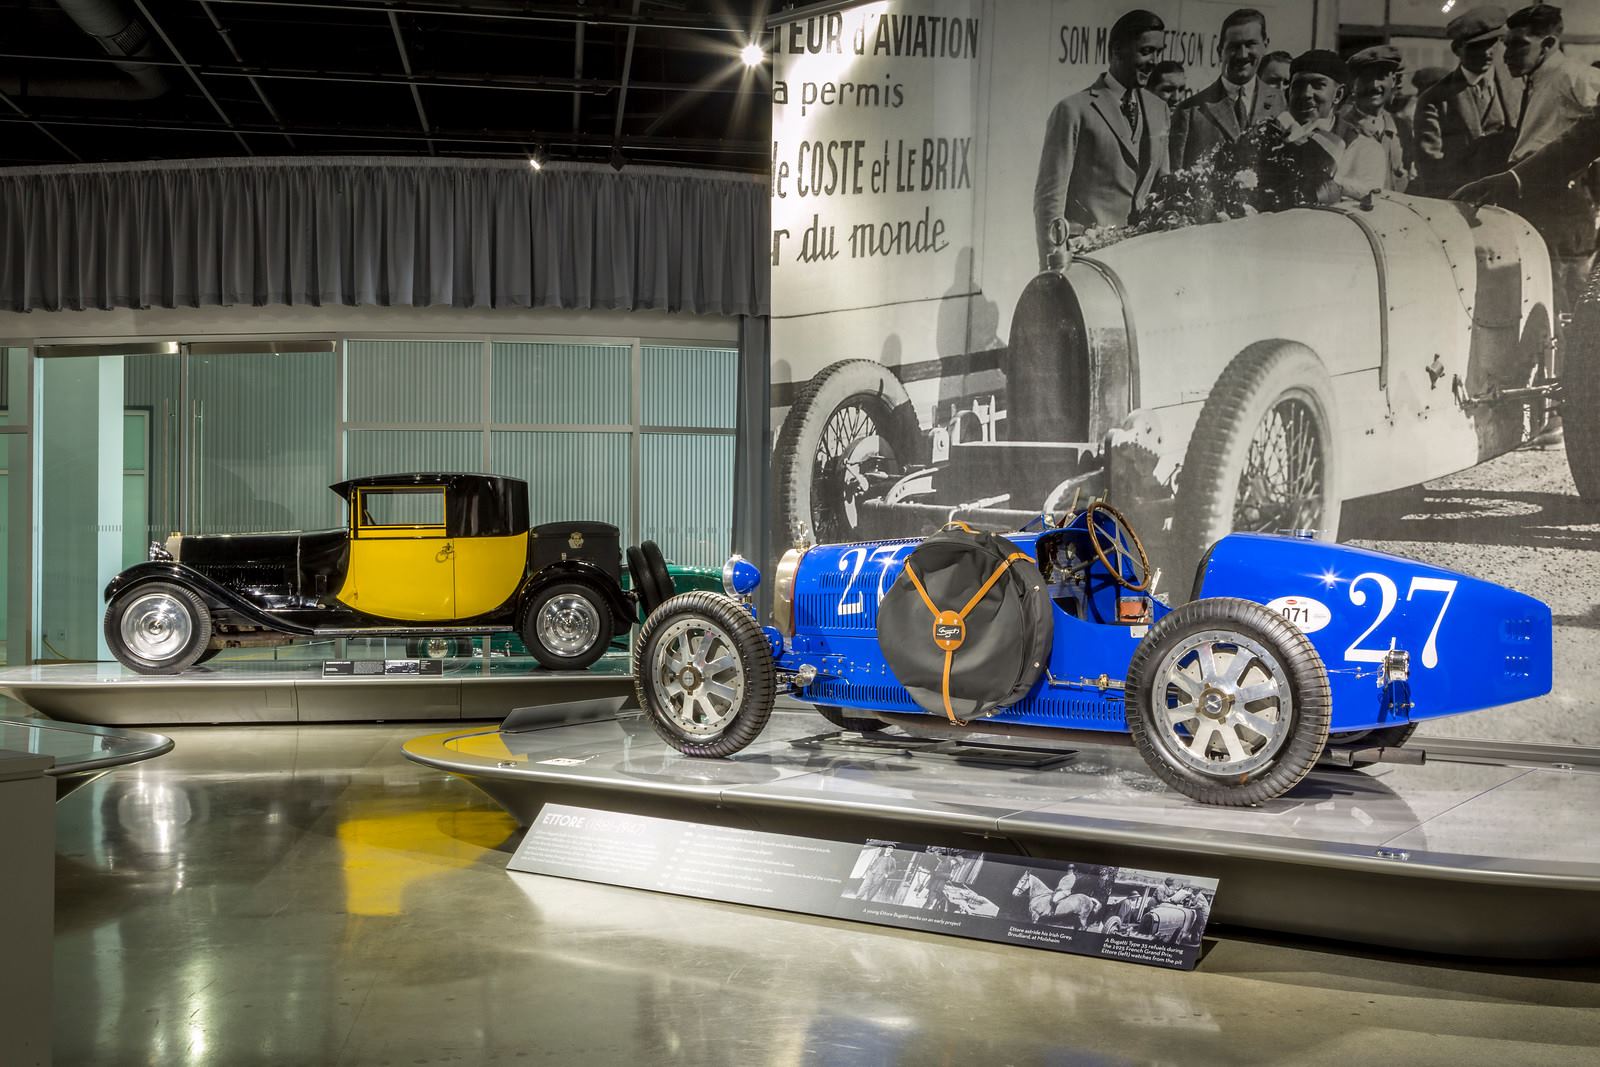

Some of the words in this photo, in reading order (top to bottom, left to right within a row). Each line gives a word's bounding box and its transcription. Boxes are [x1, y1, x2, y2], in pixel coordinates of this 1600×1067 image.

[1058, 25, 1090, 65] SON
[801, 73, 904, 117] permis
[797, 140, 866, 198] COSTE
[870, 139, 890, 194] et
[796, 213, 840, 264] du
[848, 206, 950, 259] monde
[837, 545, 906, 616] 27
[1282, 607, 1308, 623] 071
[1344, 572, 1458, 669] 27
[542, 813, 586, 829] ETTORE
[1110, 938, 1128, 946] Bugatti
[1129, 940, 1140, 948] Type
[1148, 943, 1166, 952] refuels
[1166, 946, 1184, 955] during
[1118, 950, 1131, 958] (left)
[1131, 952, 1152, 961] watches
[1126, 945, 1143, 954] French
[1144, 948, 1161, 956] Grand
